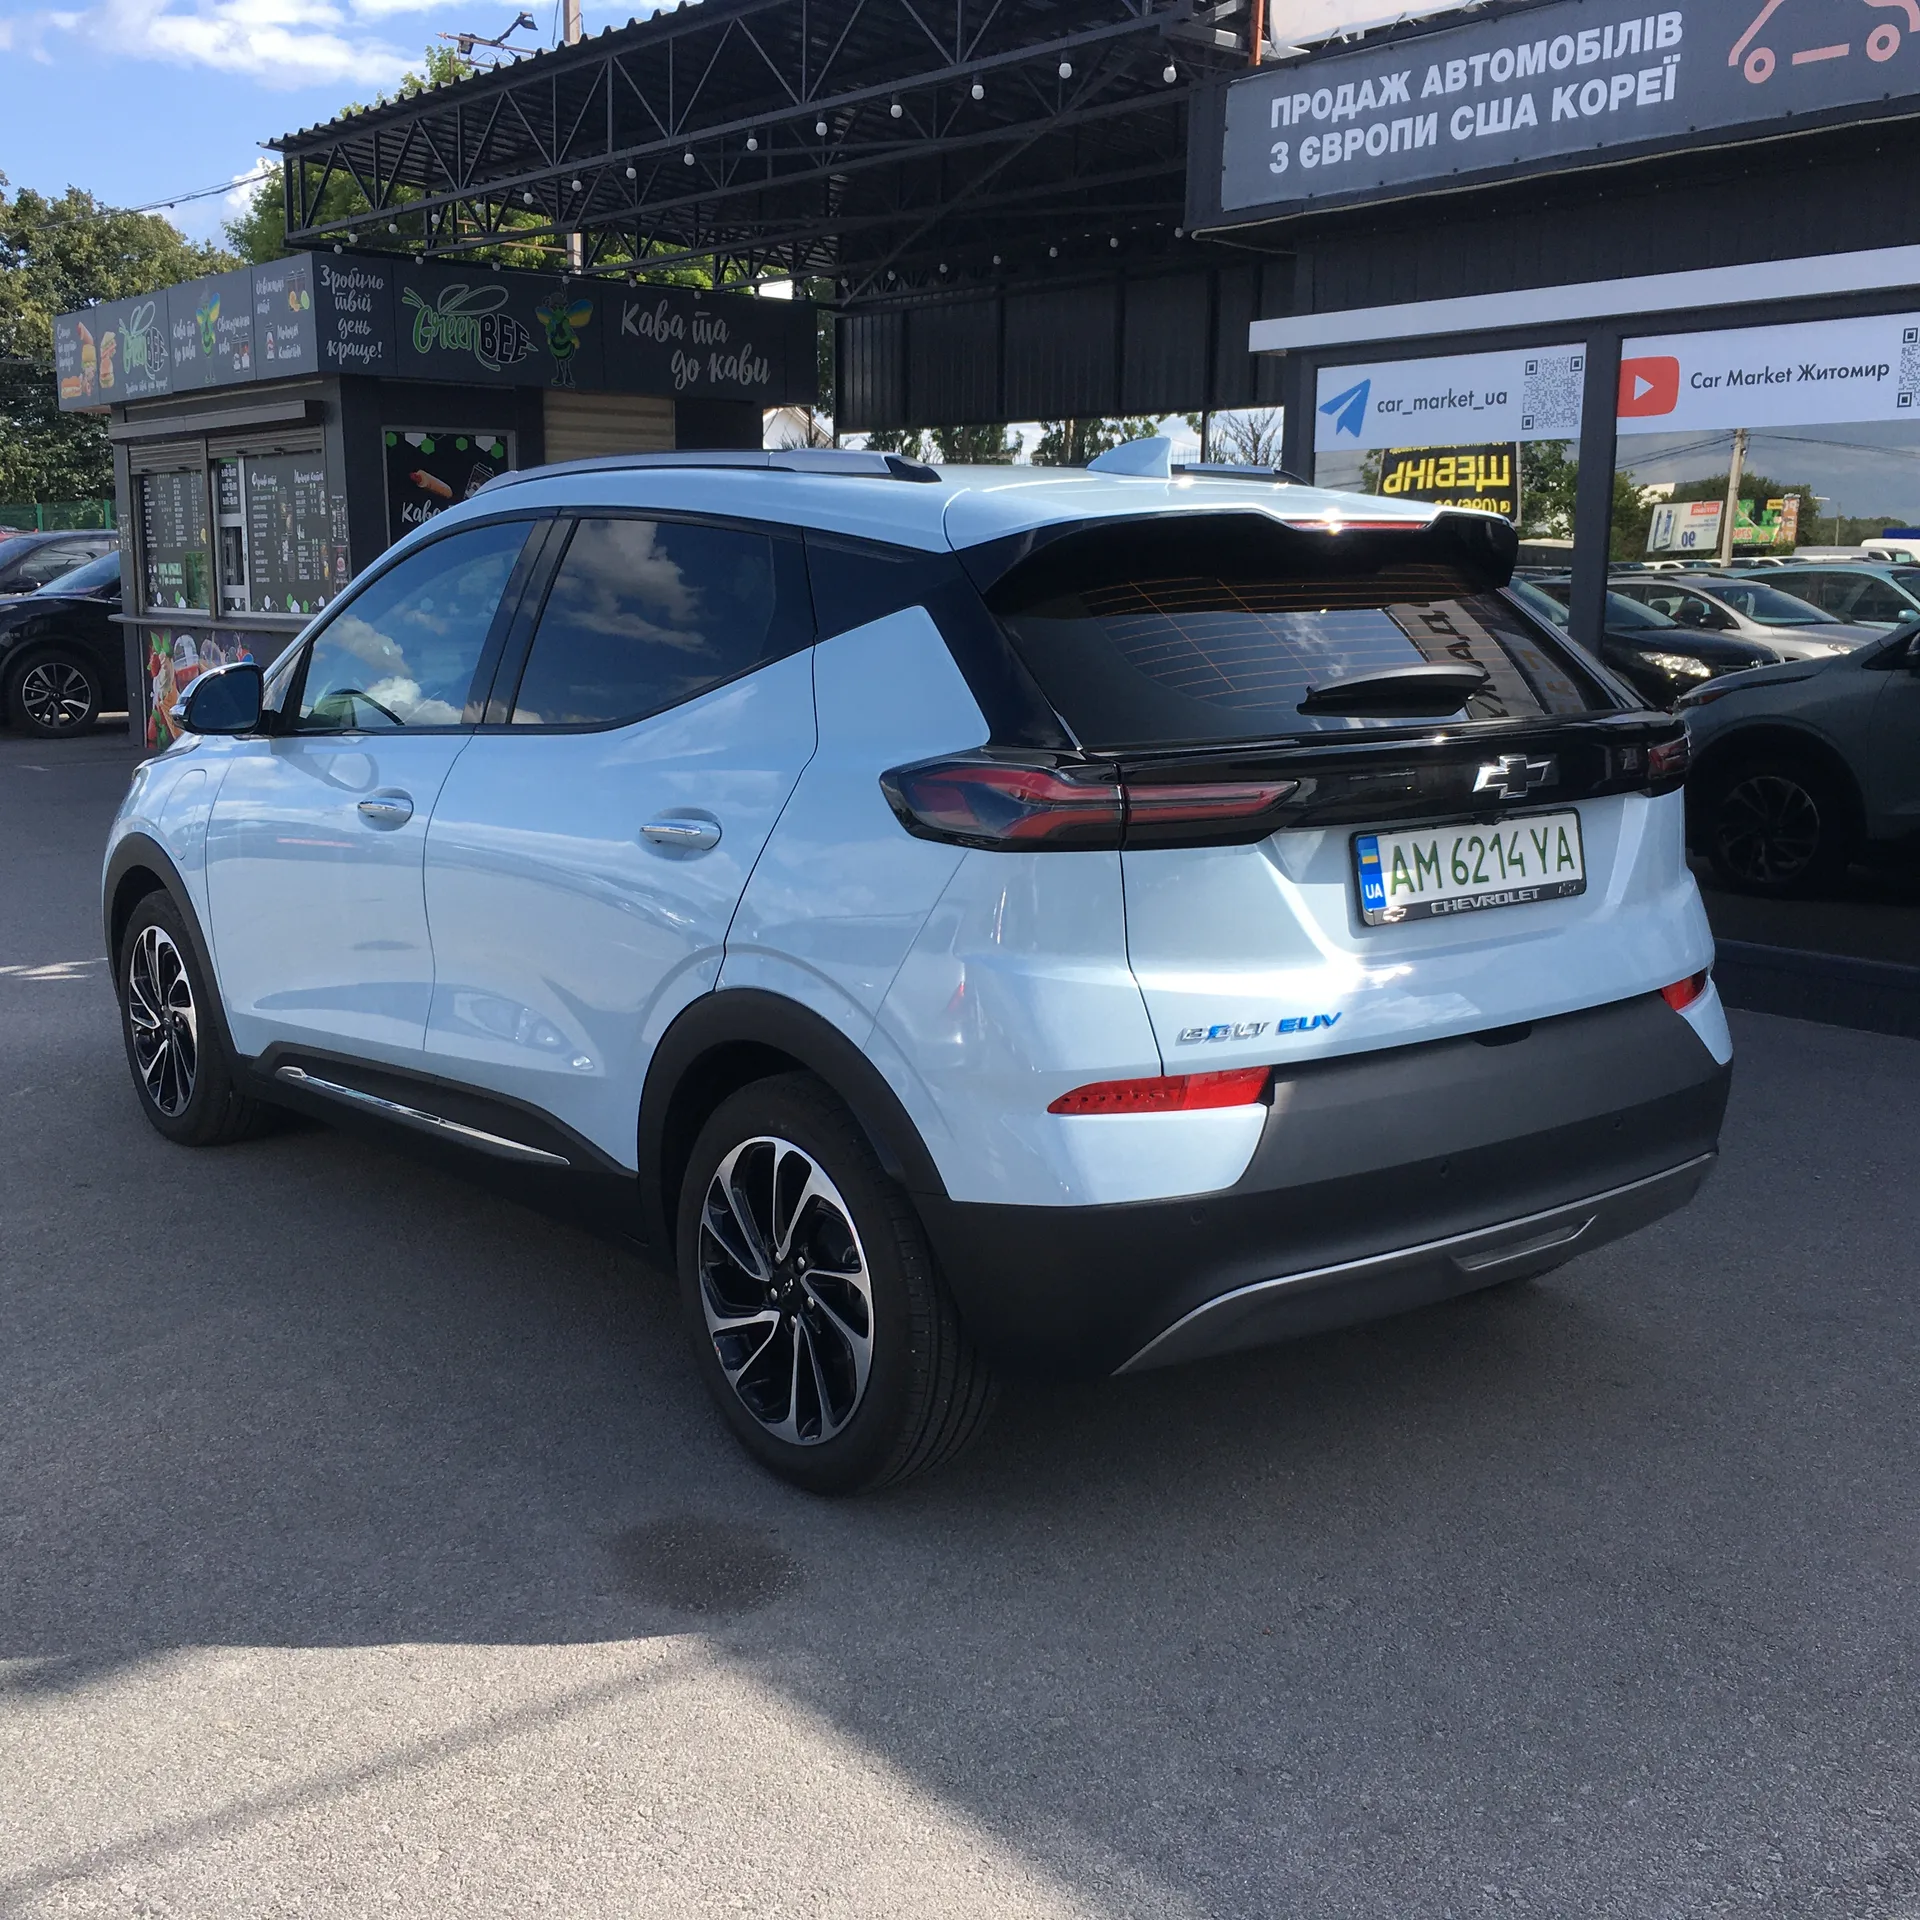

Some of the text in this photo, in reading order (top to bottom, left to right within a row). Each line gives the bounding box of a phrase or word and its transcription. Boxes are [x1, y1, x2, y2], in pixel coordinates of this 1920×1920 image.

[1271, 11, 1683, 128] ПРОДАЖ АВТОМОБІЛІВ
[1269, 54, 1682, 173] З ЄВРОПИ США КОРЕЇ
[320, 265, 384, 294] Зробимо
[334, 289, 372, 312] твій
[337, 317, 372, 339] день
[621, 300, 730, 346] Кава та
[326, 340, 383, 364] краще!
[671, 343, 771, 390] до кави
[1690, 363, 1891, 389] Car Market Житомир
[1377, 388, 1508, 415] car_market_ua
[1391, 826, 1575, 895] AM 6214 YA
[1365, 883, 1383, 900] UA
[1431, 887, 1541, 915] CHEVROLET
[1275, 1011, 1342, 1036] EUV
